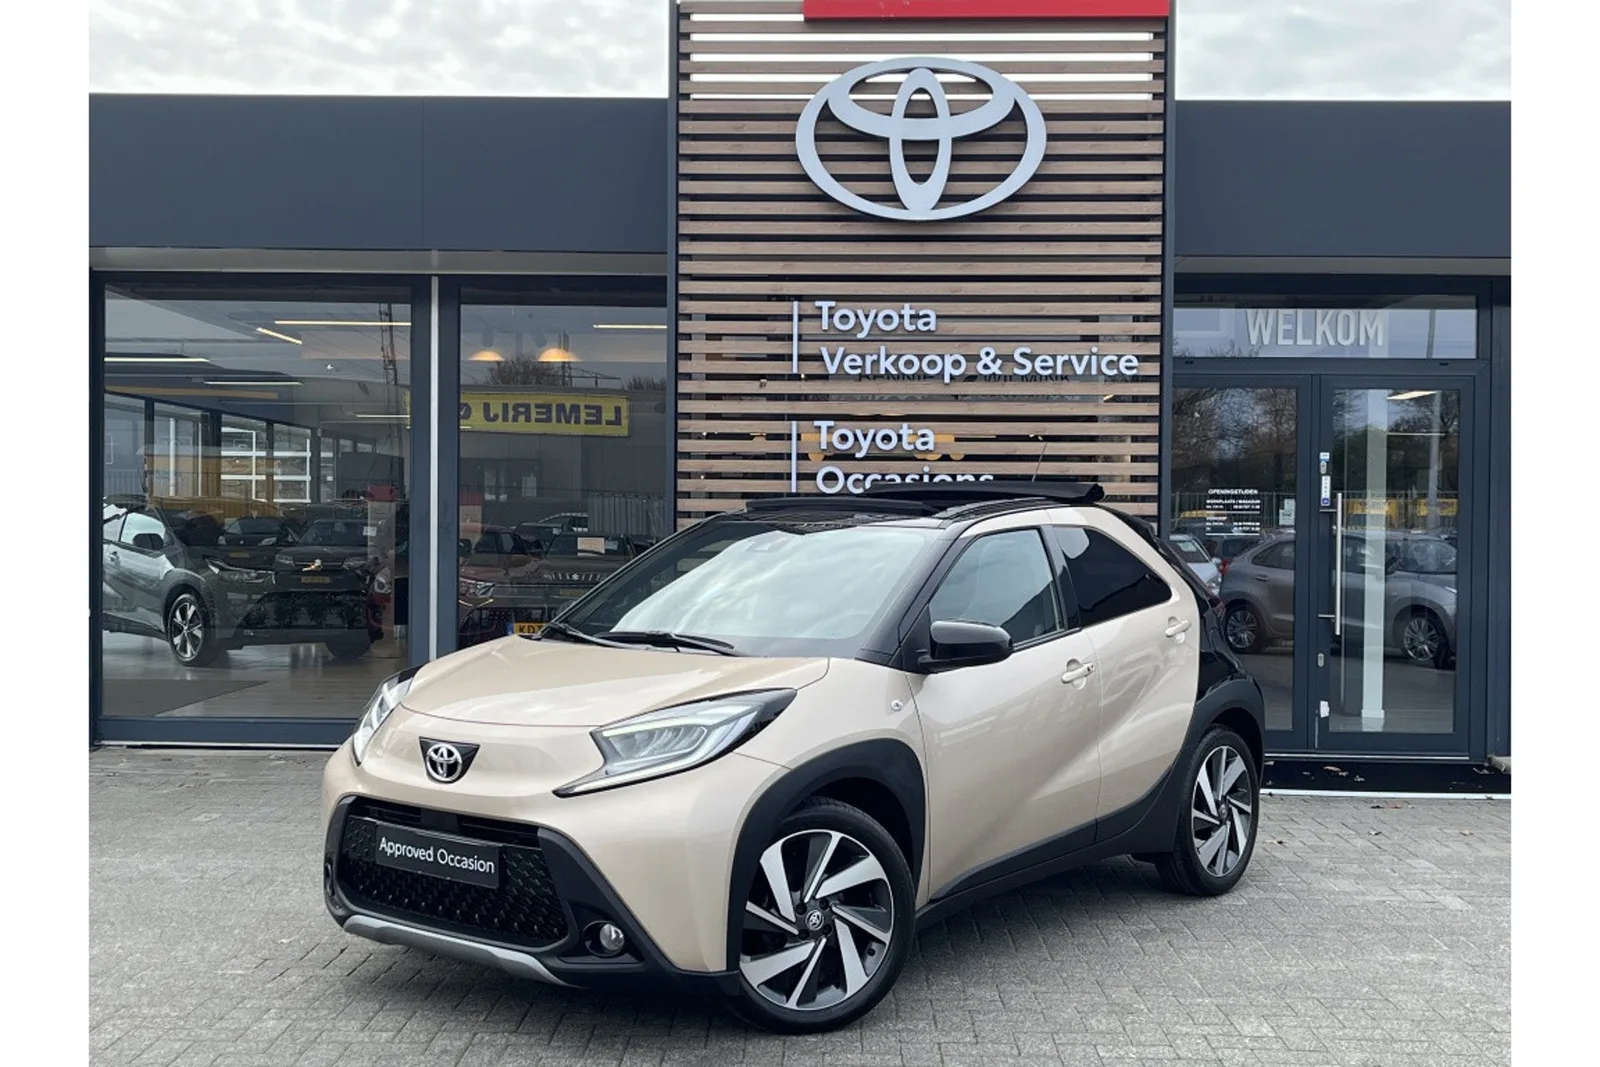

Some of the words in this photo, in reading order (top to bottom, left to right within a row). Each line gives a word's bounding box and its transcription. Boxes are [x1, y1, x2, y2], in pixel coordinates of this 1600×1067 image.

[815, 301, 937, 339] Toyota
[1246, 309, 1384, 346] WELKOM
[820, 346, 967, 384] Verkoop
[976, 346, 1003, 376] &
[1013, 346, 1139, 376] Service
[813, 421, 935, 458] Toyota
[379, 836, 434, 862] Approved
[437, 848, 495, 874] Occasion
